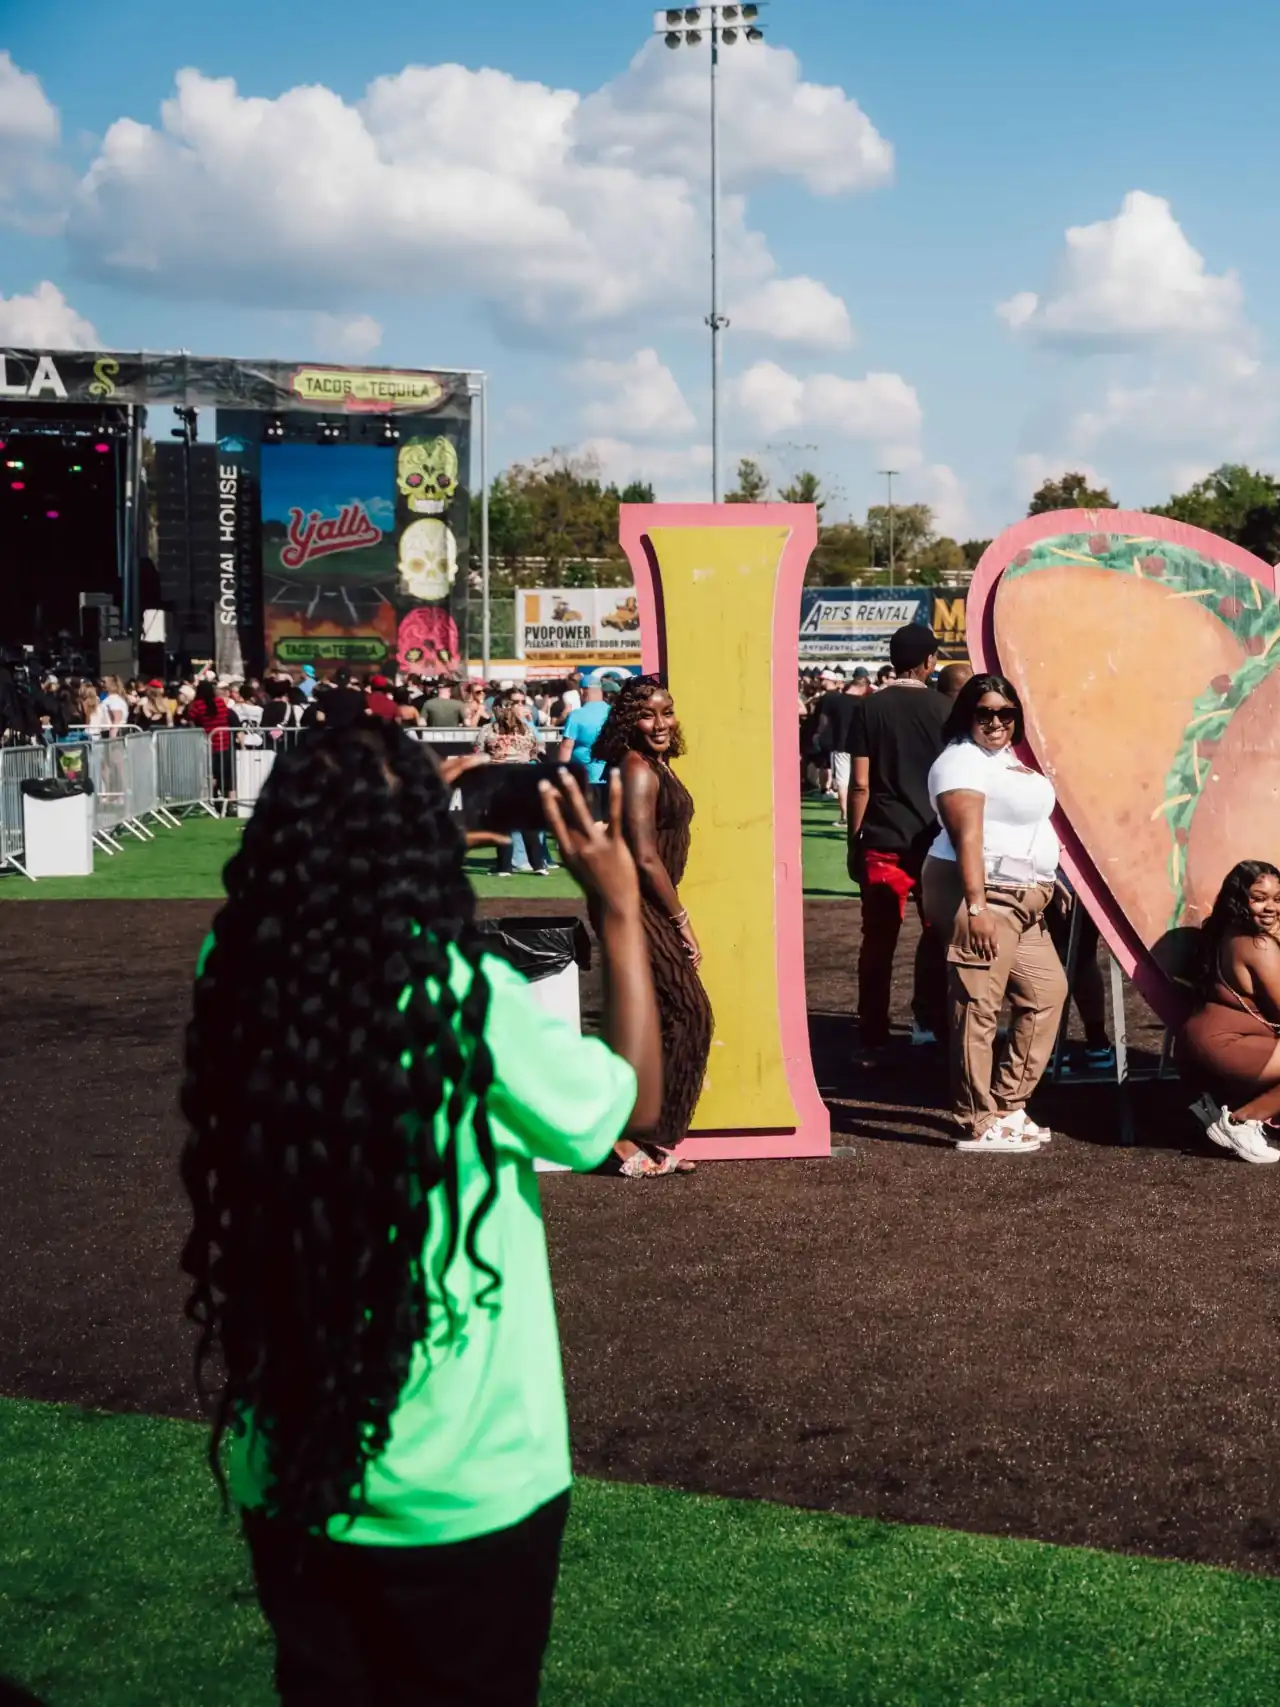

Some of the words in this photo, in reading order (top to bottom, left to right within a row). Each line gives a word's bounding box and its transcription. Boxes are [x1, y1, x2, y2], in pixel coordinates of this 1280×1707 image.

[306, 377, 352, 394] TACOS
[369, 381, 430, 399] TEQUILA
[219, 465, 238, 542] HOUSE
[219, 550, 237, 625] SOCIAL
[804, 604, 852, 632] ART'S
[856, 605, 909, 621] RENTAL
[525, 626, 592, 640] PVOPOWER
[525, 640, 558, 649] PLEASANT
[560, 640, 584, 649] VALLEY
[619, 503, 831, 1162] I
